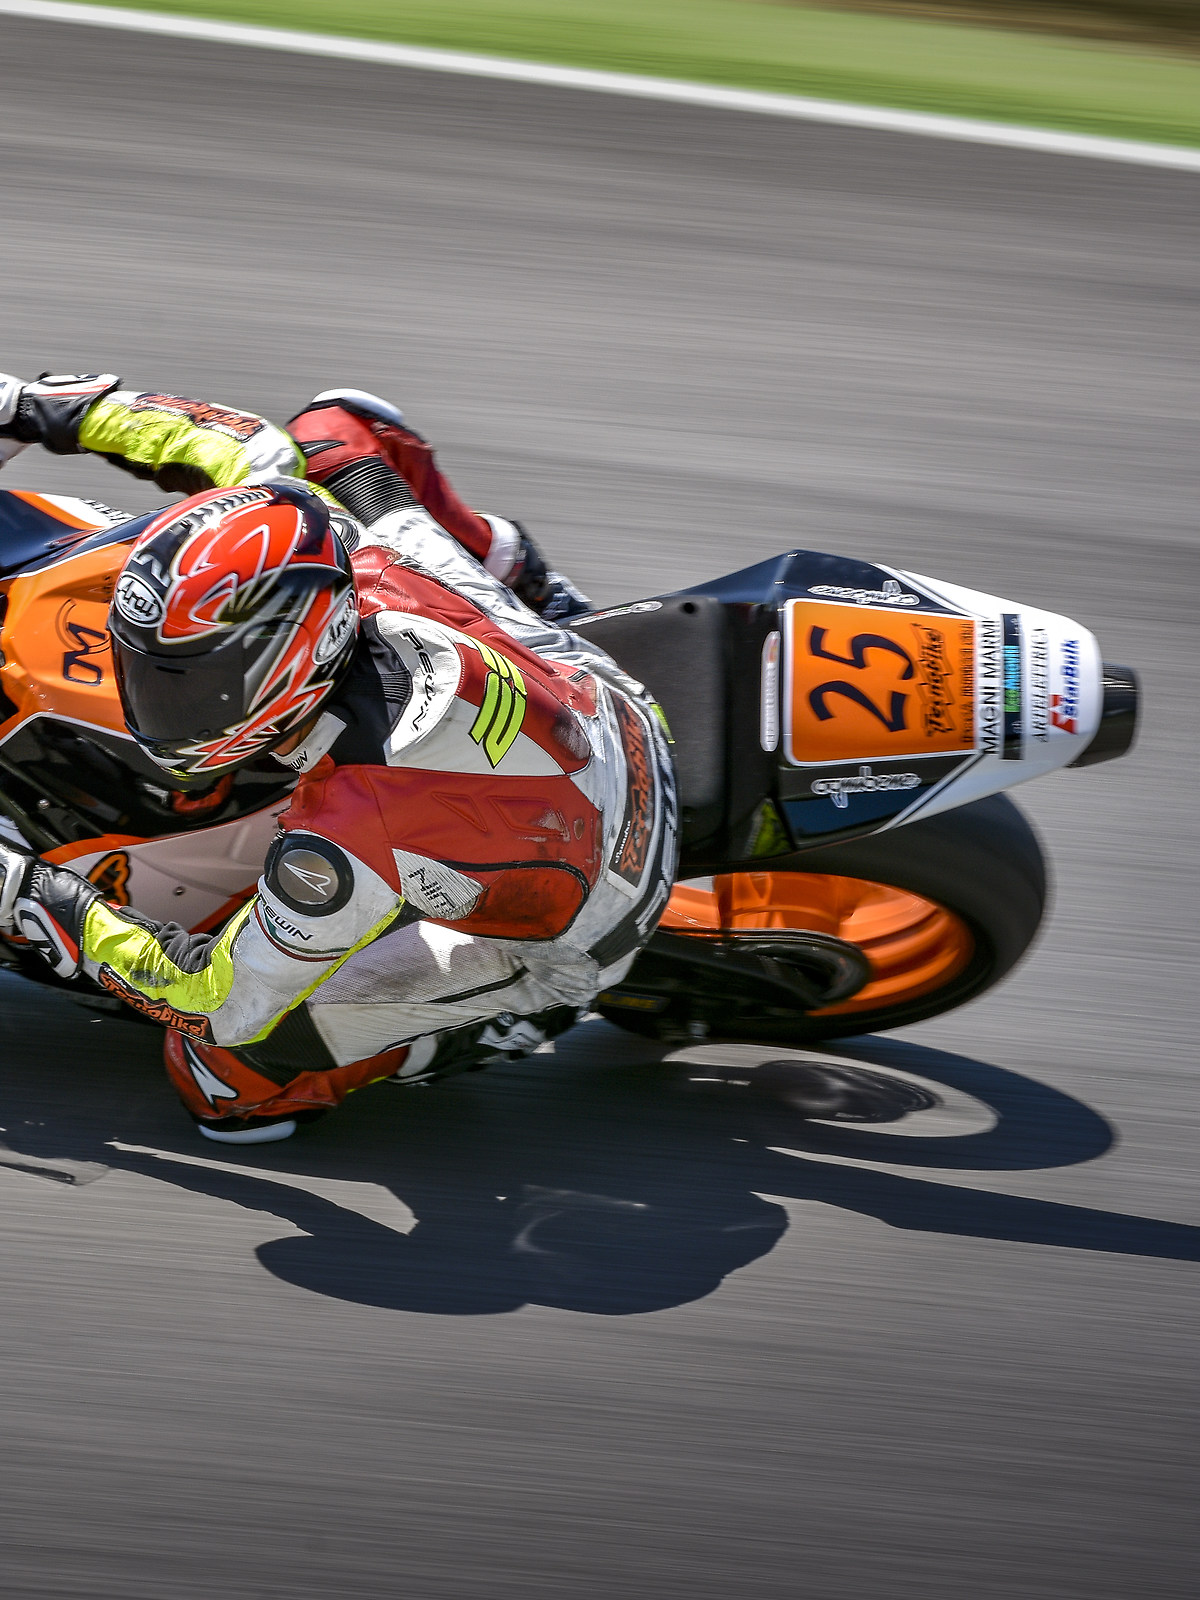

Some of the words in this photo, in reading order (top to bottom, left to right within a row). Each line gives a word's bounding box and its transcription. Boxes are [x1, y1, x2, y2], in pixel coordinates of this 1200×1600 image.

[807, 625, 914, 732] 25
[980, 620, 1000, 678] MARMI
[980, 686, 1000, 754] MAGNI
